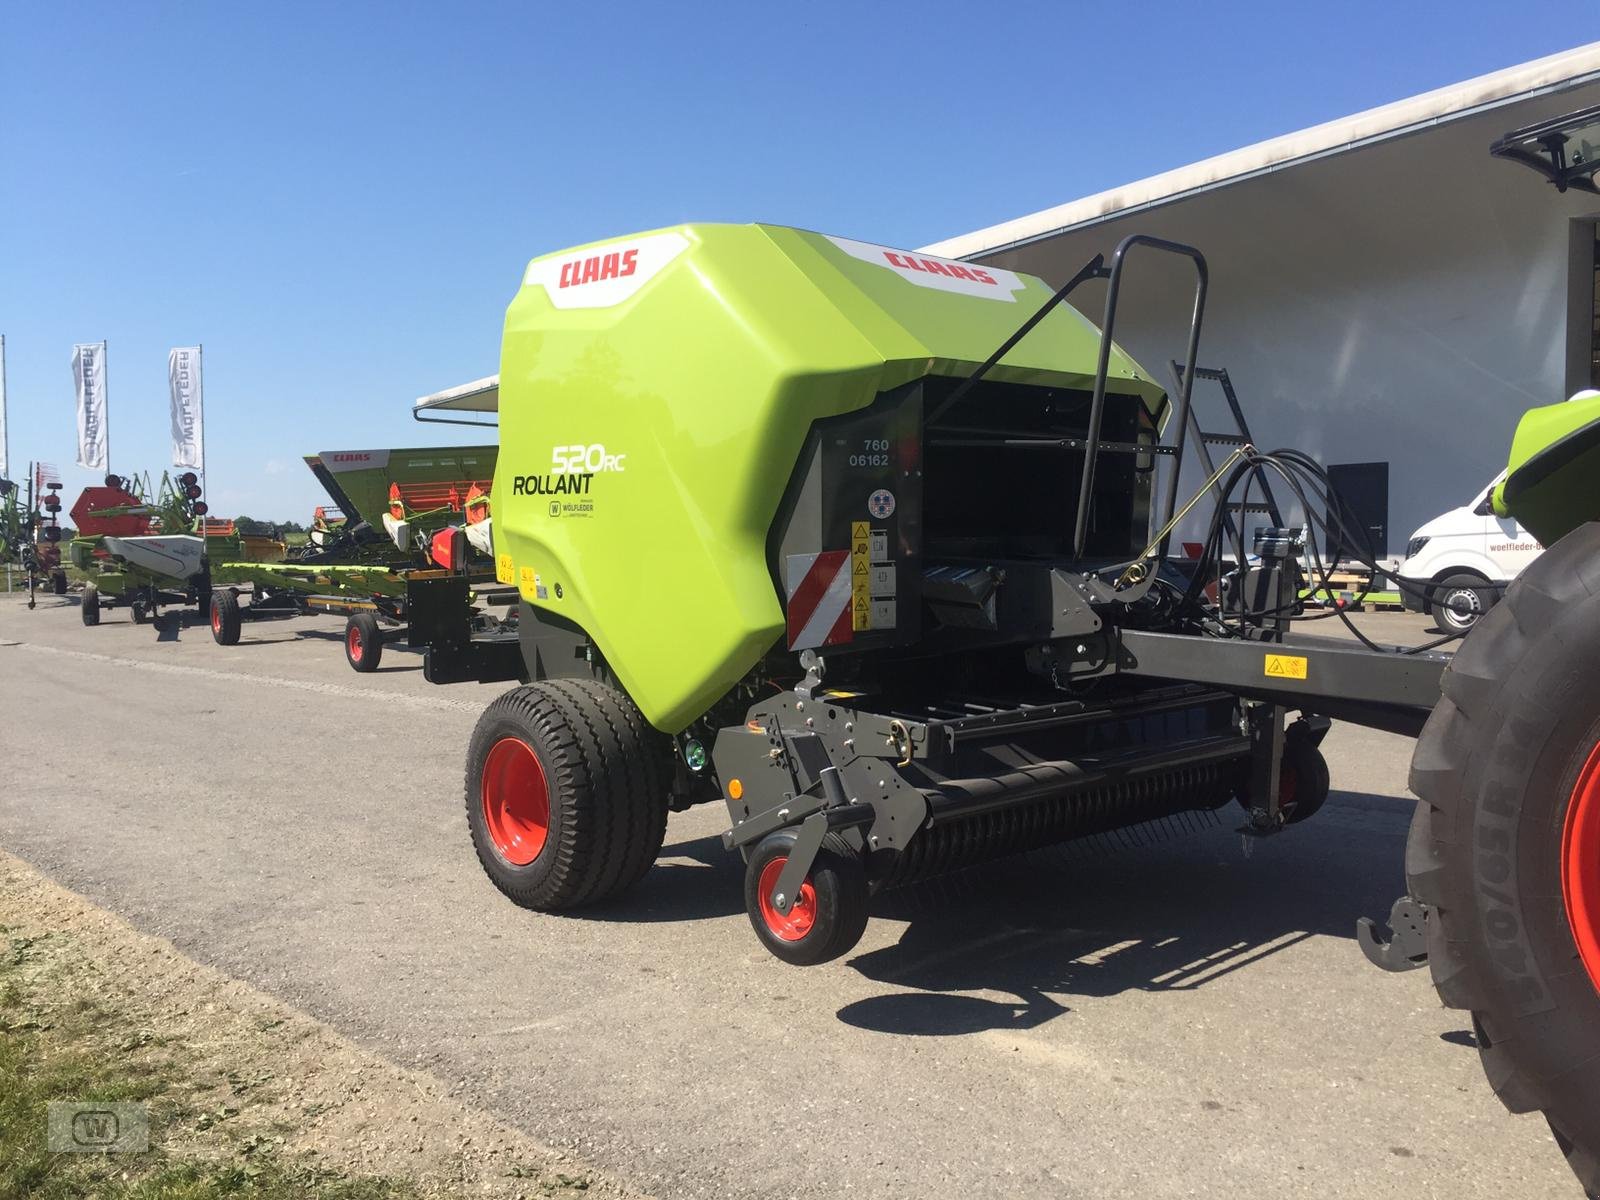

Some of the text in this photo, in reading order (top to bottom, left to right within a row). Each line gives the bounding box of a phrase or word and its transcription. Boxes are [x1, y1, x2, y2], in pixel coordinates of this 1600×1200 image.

[559, 248, 639, 288] CLAAS
[883, 251, 998, 285] CLAAS
[864, 439, 889, 451] 760
[333, 453, 370, 462] CLAAS
[849, 455, 889, 466] 06162
[513, 473, 594, 496] ROLLANT
